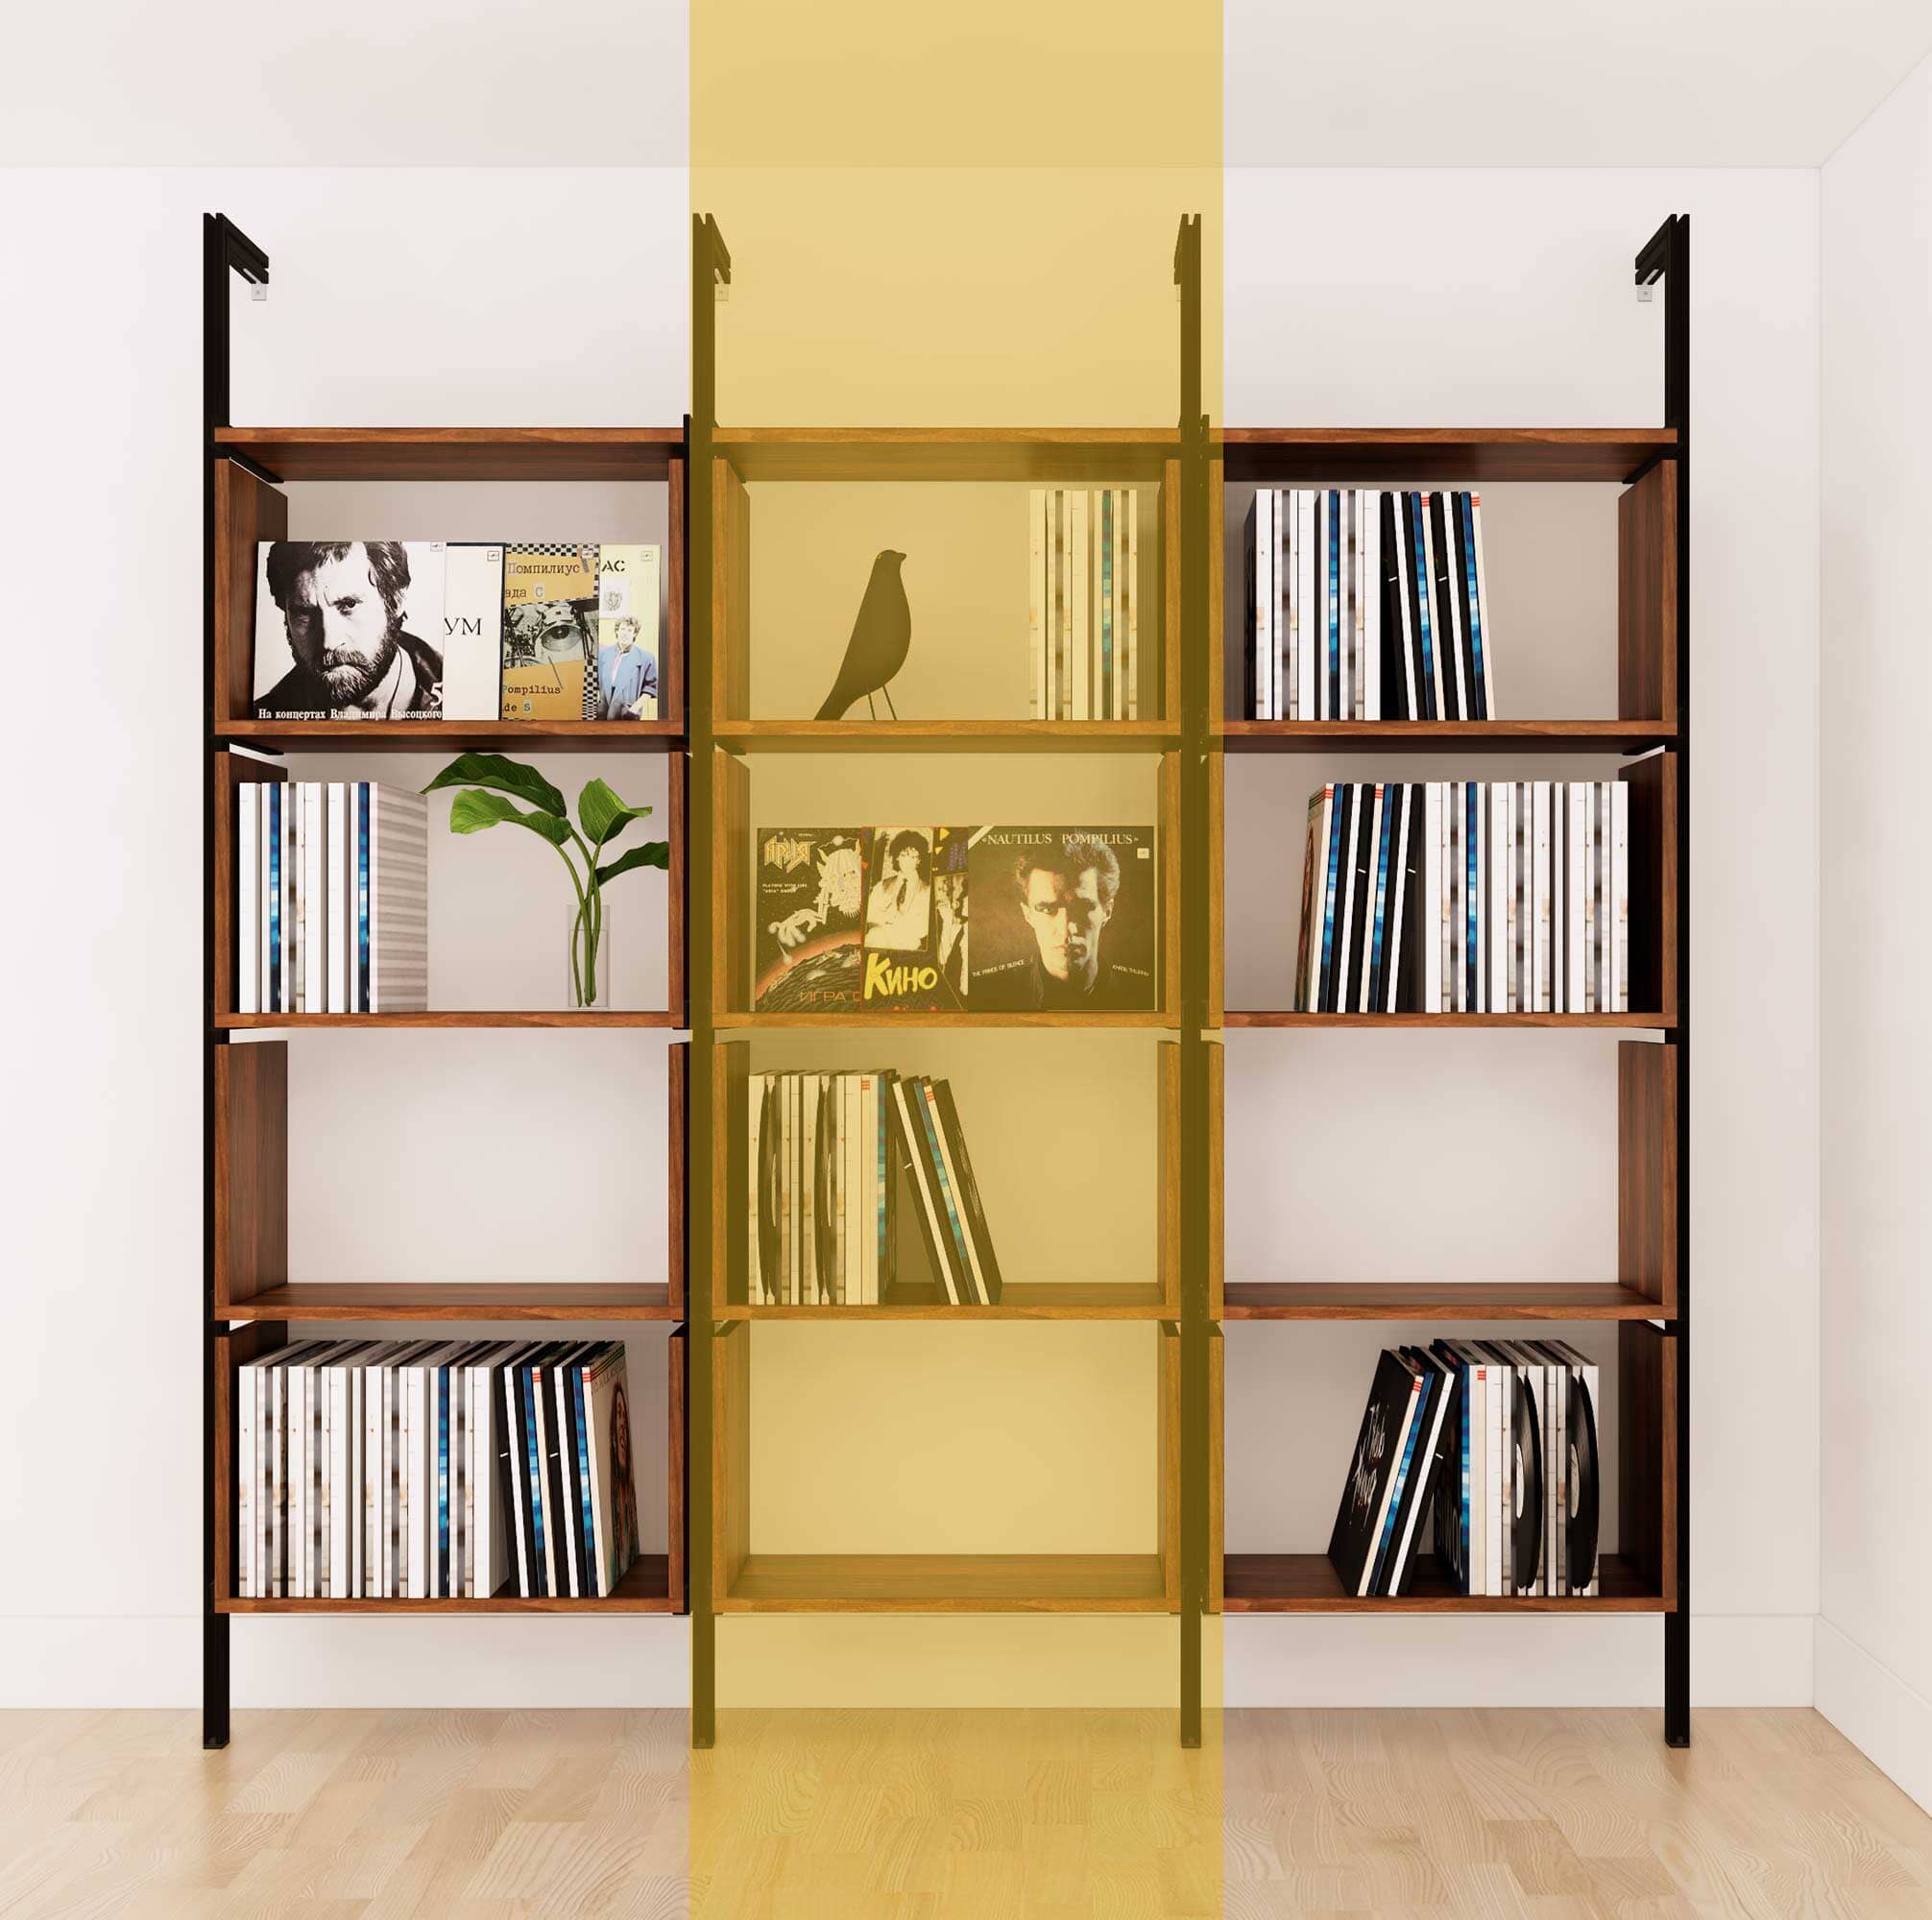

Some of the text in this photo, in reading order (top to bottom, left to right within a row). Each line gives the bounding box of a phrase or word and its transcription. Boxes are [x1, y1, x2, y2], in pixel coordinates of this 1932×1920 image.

[507, 562, 580, 576] Помпилиус
[430, 683, 443, 707] 5
[258, 708, 443, 720] На концертах Владимира Высоцкого
[799, 991, 846, 1002] ИГРА
